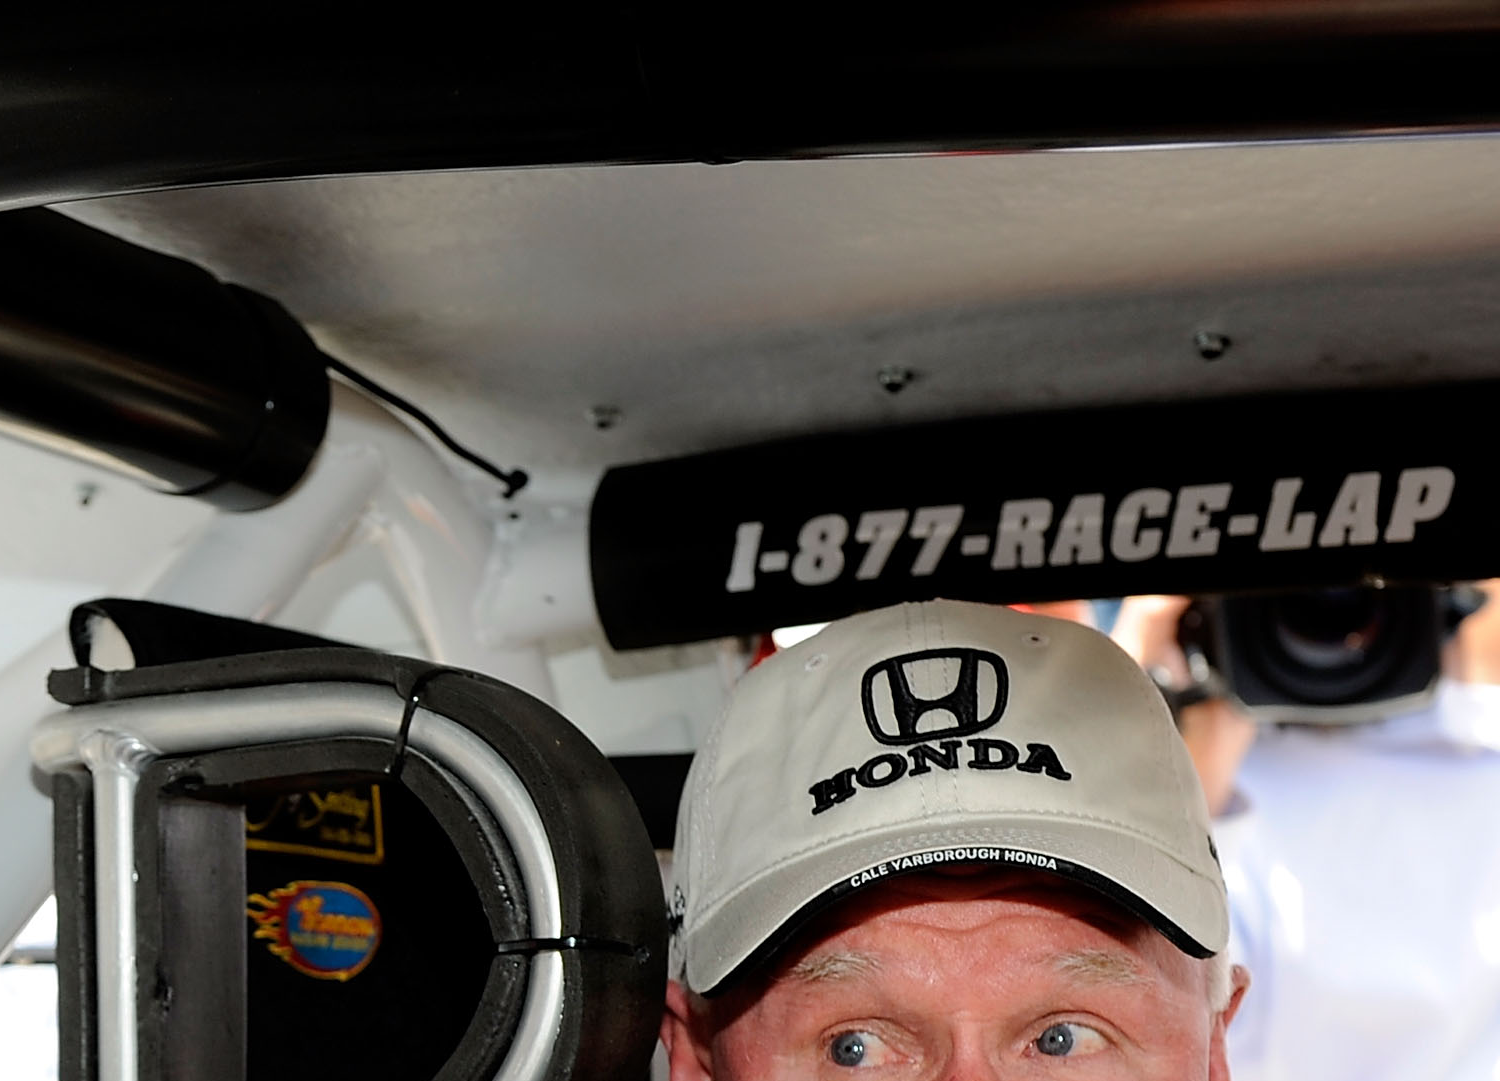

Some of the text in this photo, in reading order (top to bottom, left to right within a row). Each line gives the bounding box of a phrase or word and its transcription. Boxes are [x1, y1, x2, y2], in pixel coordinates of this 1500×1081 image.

[726, 466, 1456, 592] 1-877-RACE-LAP
[808, 738, 1072, 816] HONDA
[850, 847, 1058, 888] CALE YARBOROUGH HONDA
